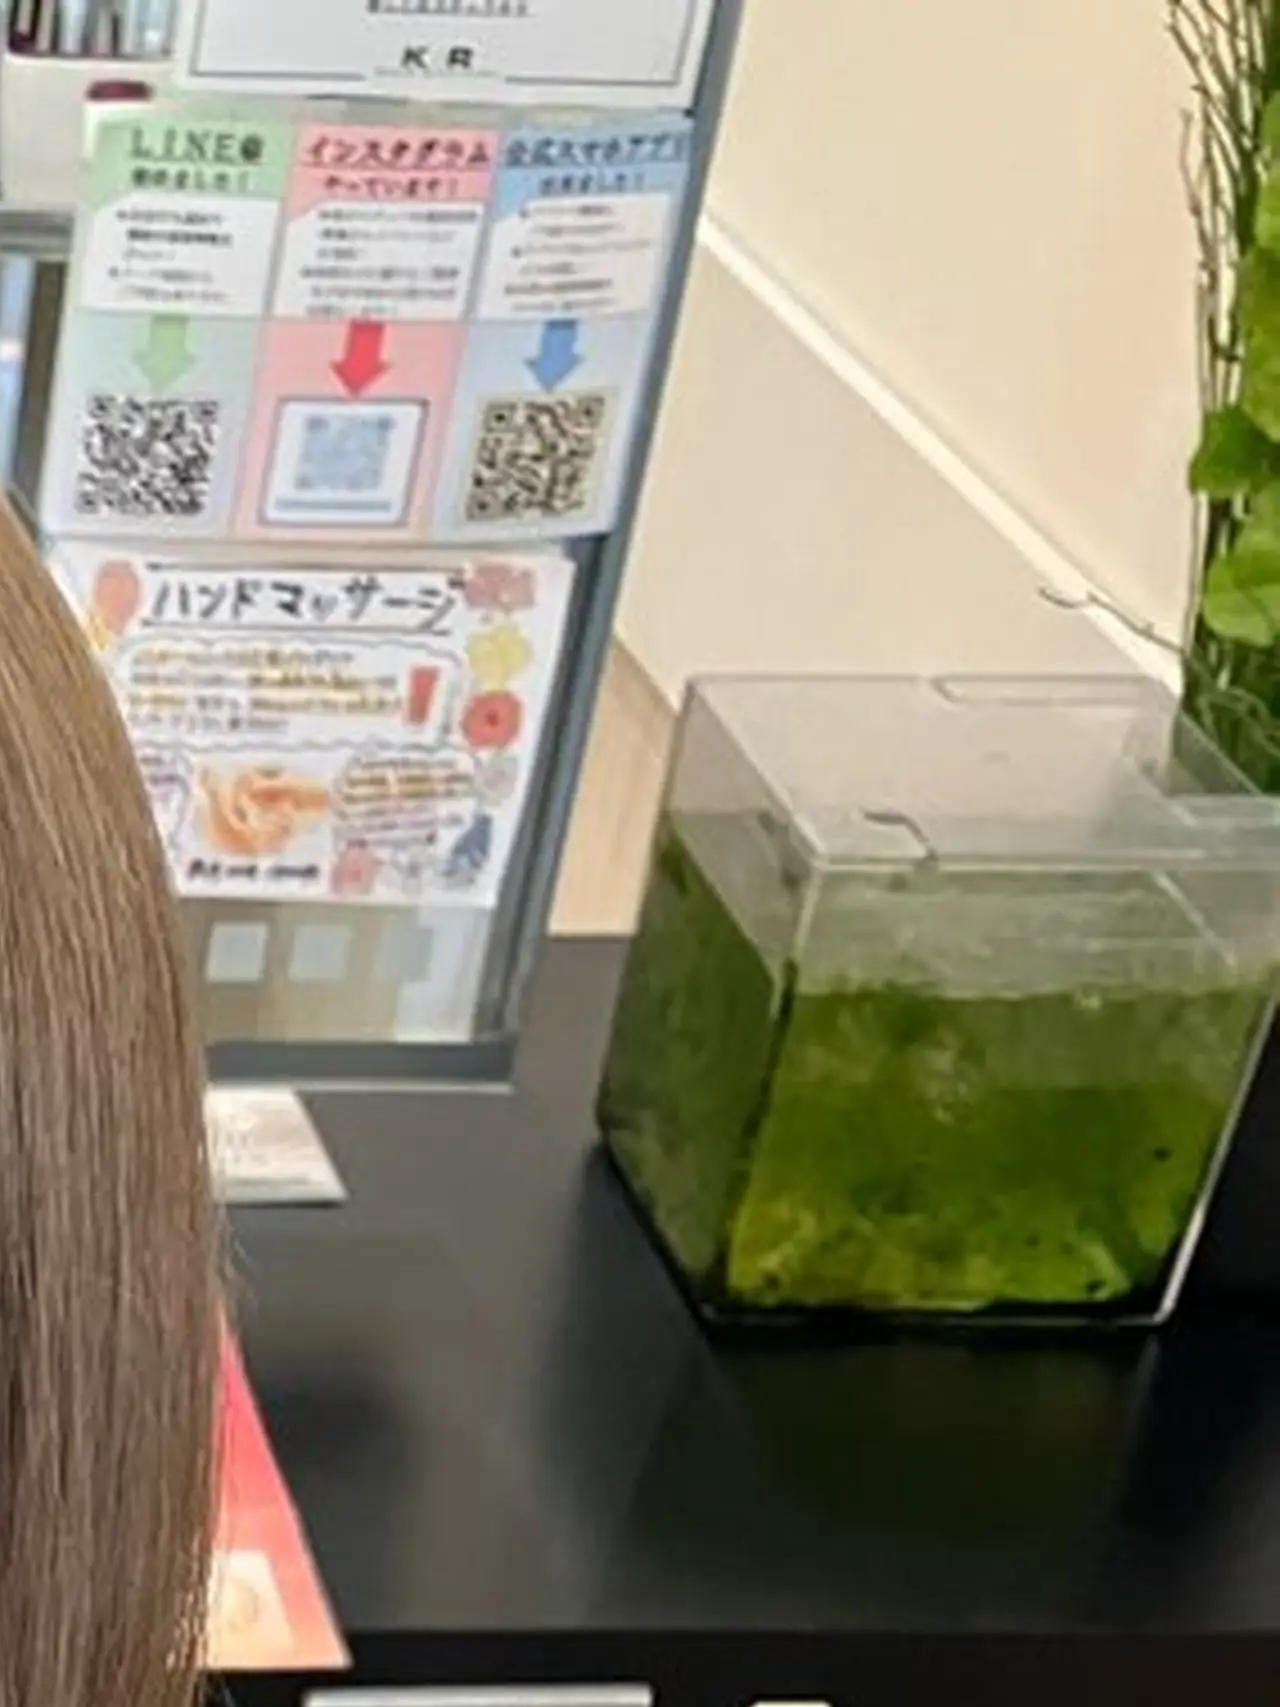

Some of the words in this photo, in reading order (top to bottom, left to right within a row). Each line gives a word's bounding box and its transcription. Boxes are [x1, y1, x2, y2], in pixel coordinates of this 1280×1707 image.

[304, 137, 492, 170] インスタグラム
[151, 574, 466, 633] ハンドマッサージ
